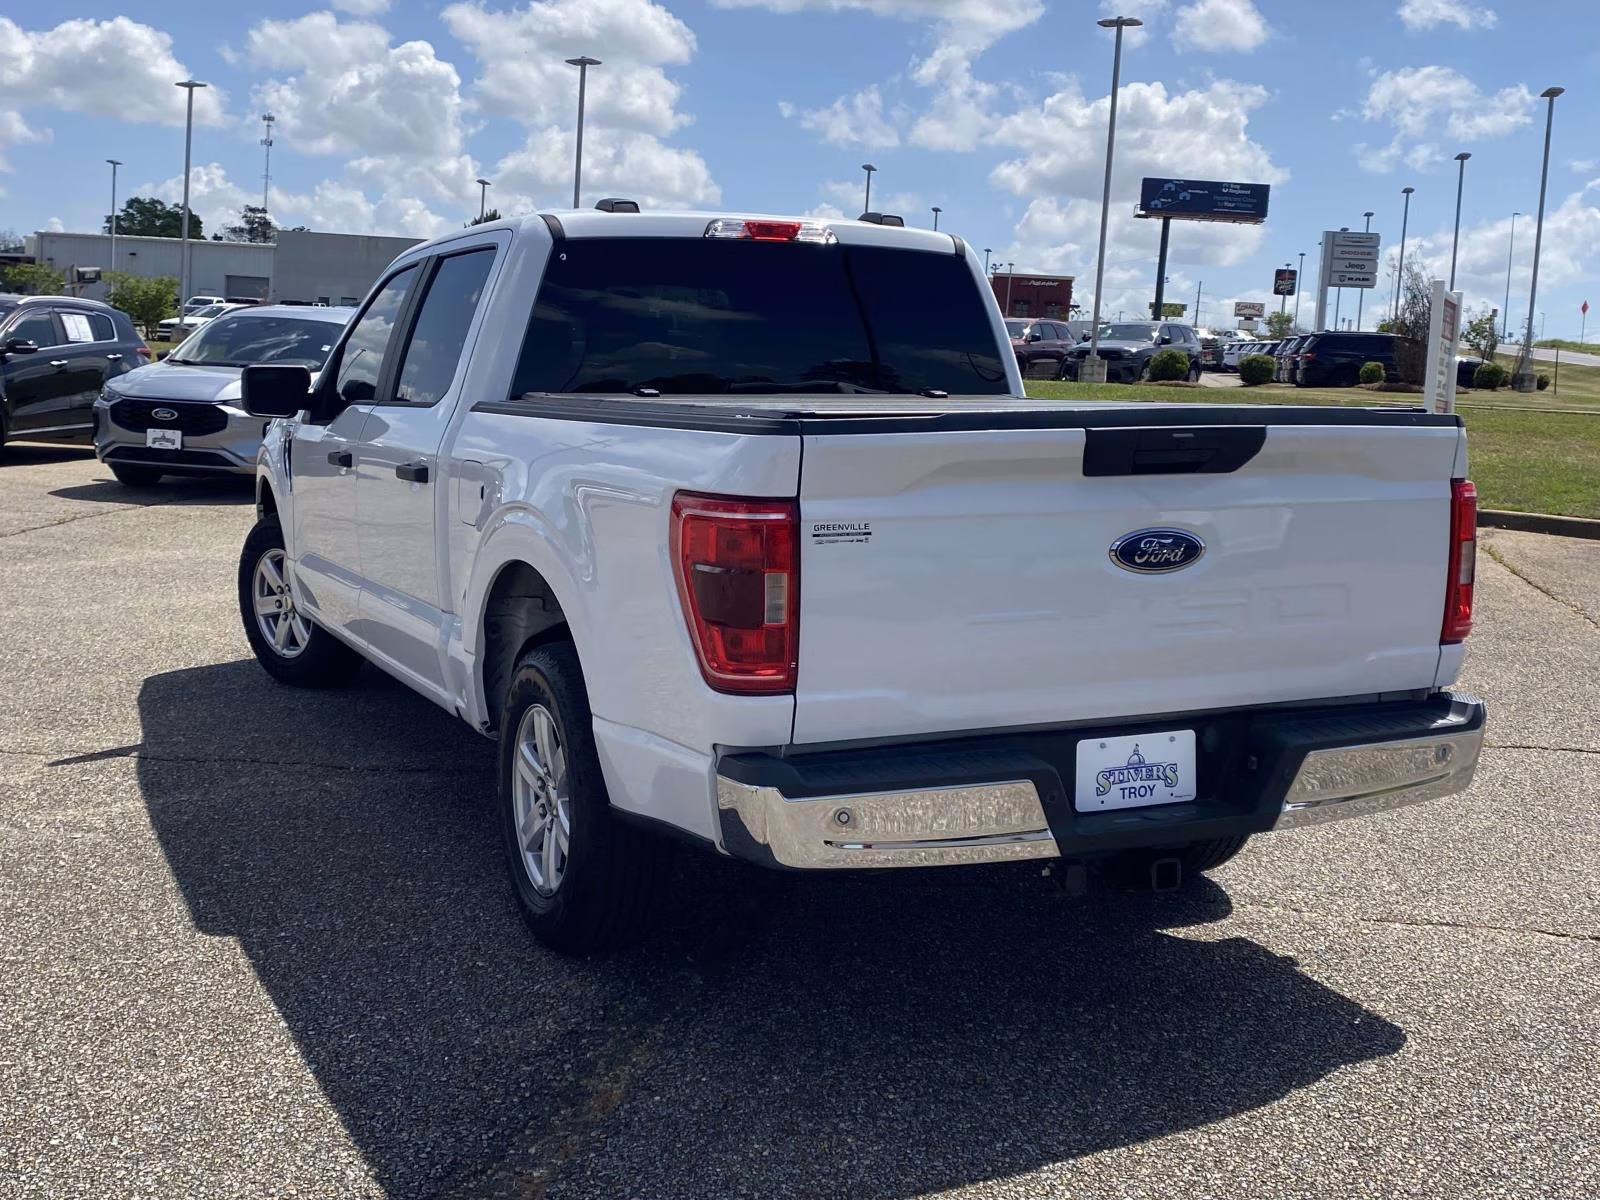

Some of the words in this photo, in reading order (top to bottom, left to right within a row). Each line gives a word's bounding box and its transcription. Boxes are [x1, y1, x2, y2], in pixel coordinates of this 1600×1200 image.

[1345, 262, 1366, 270] Jeep
[813, 522, 871, 532] GREENVILLE
[1134, 537, 1187, 563] Ford
[1096, 763, 1179, 797] STIVERS
[1119, 783, 1157, 800] TROY
